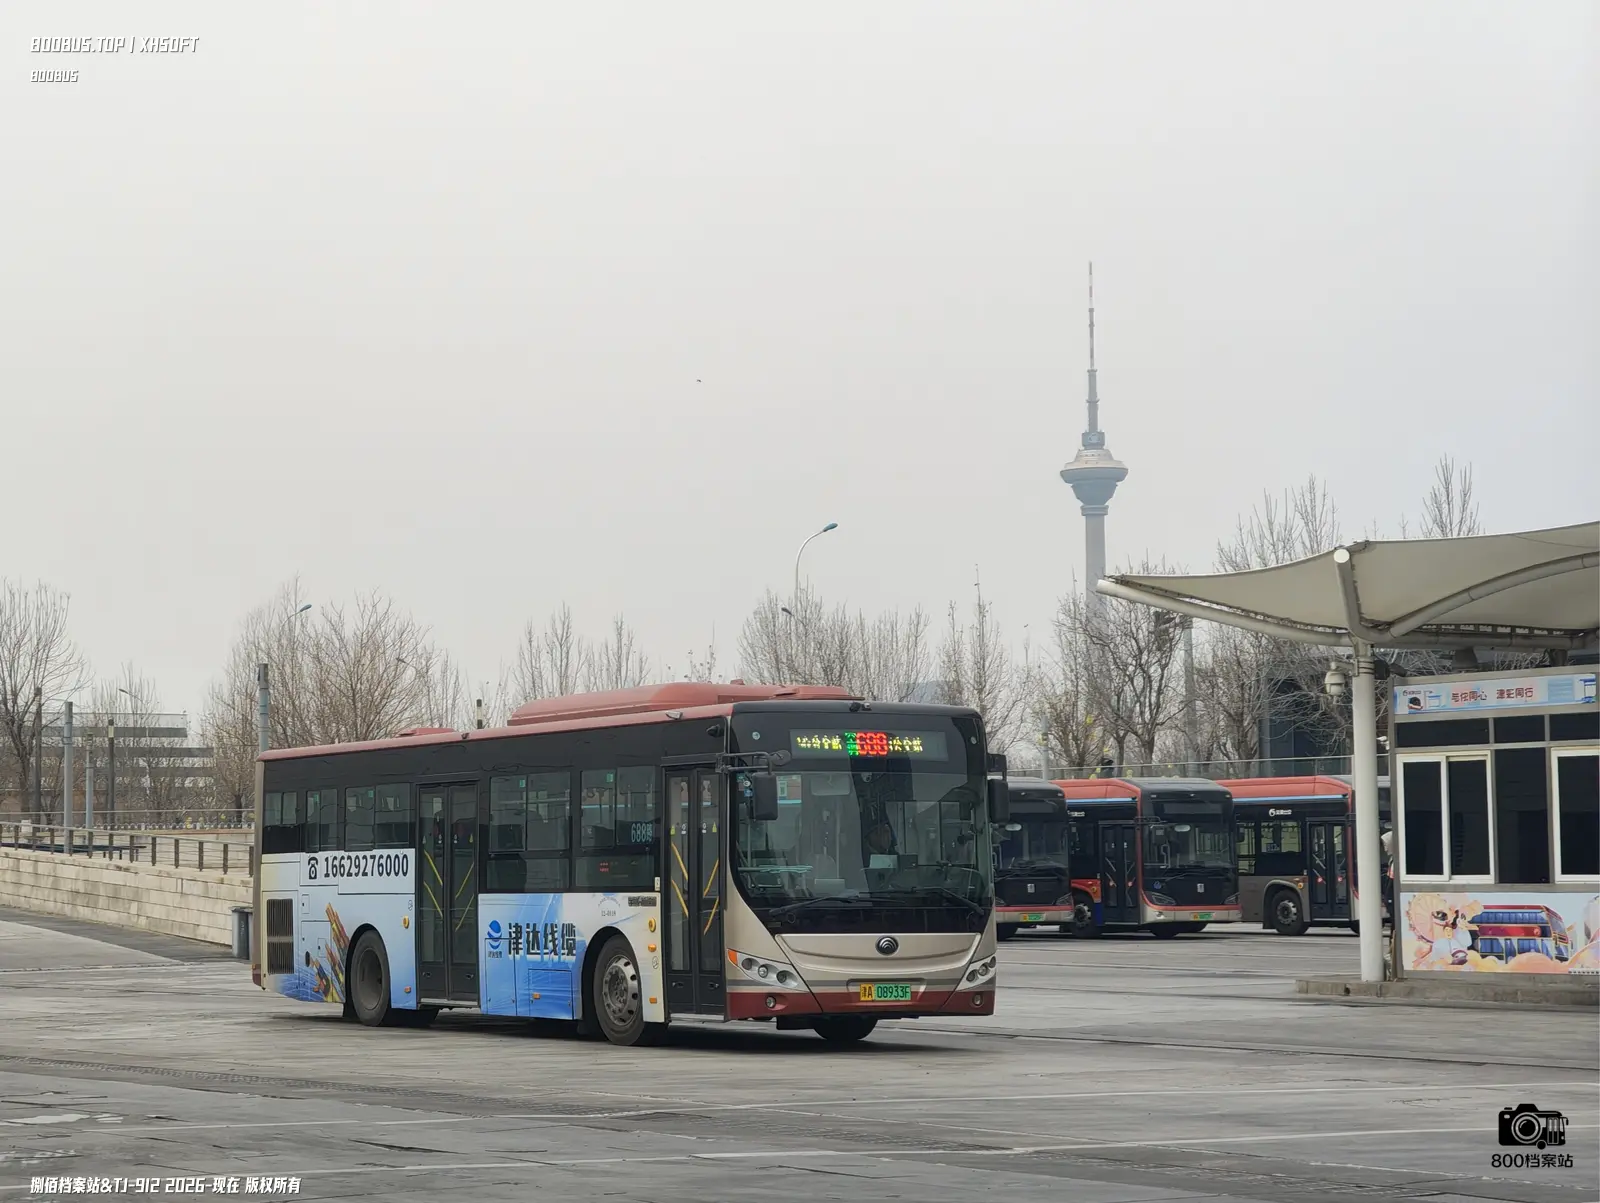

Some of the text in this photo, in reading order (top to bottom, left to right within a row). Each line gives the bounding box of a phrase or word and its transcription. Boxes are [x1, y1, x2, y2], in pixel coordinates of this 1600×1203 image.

[324, 853, 409, 878] 16629276000
[508, 922, 576, 956] 津达线缆
